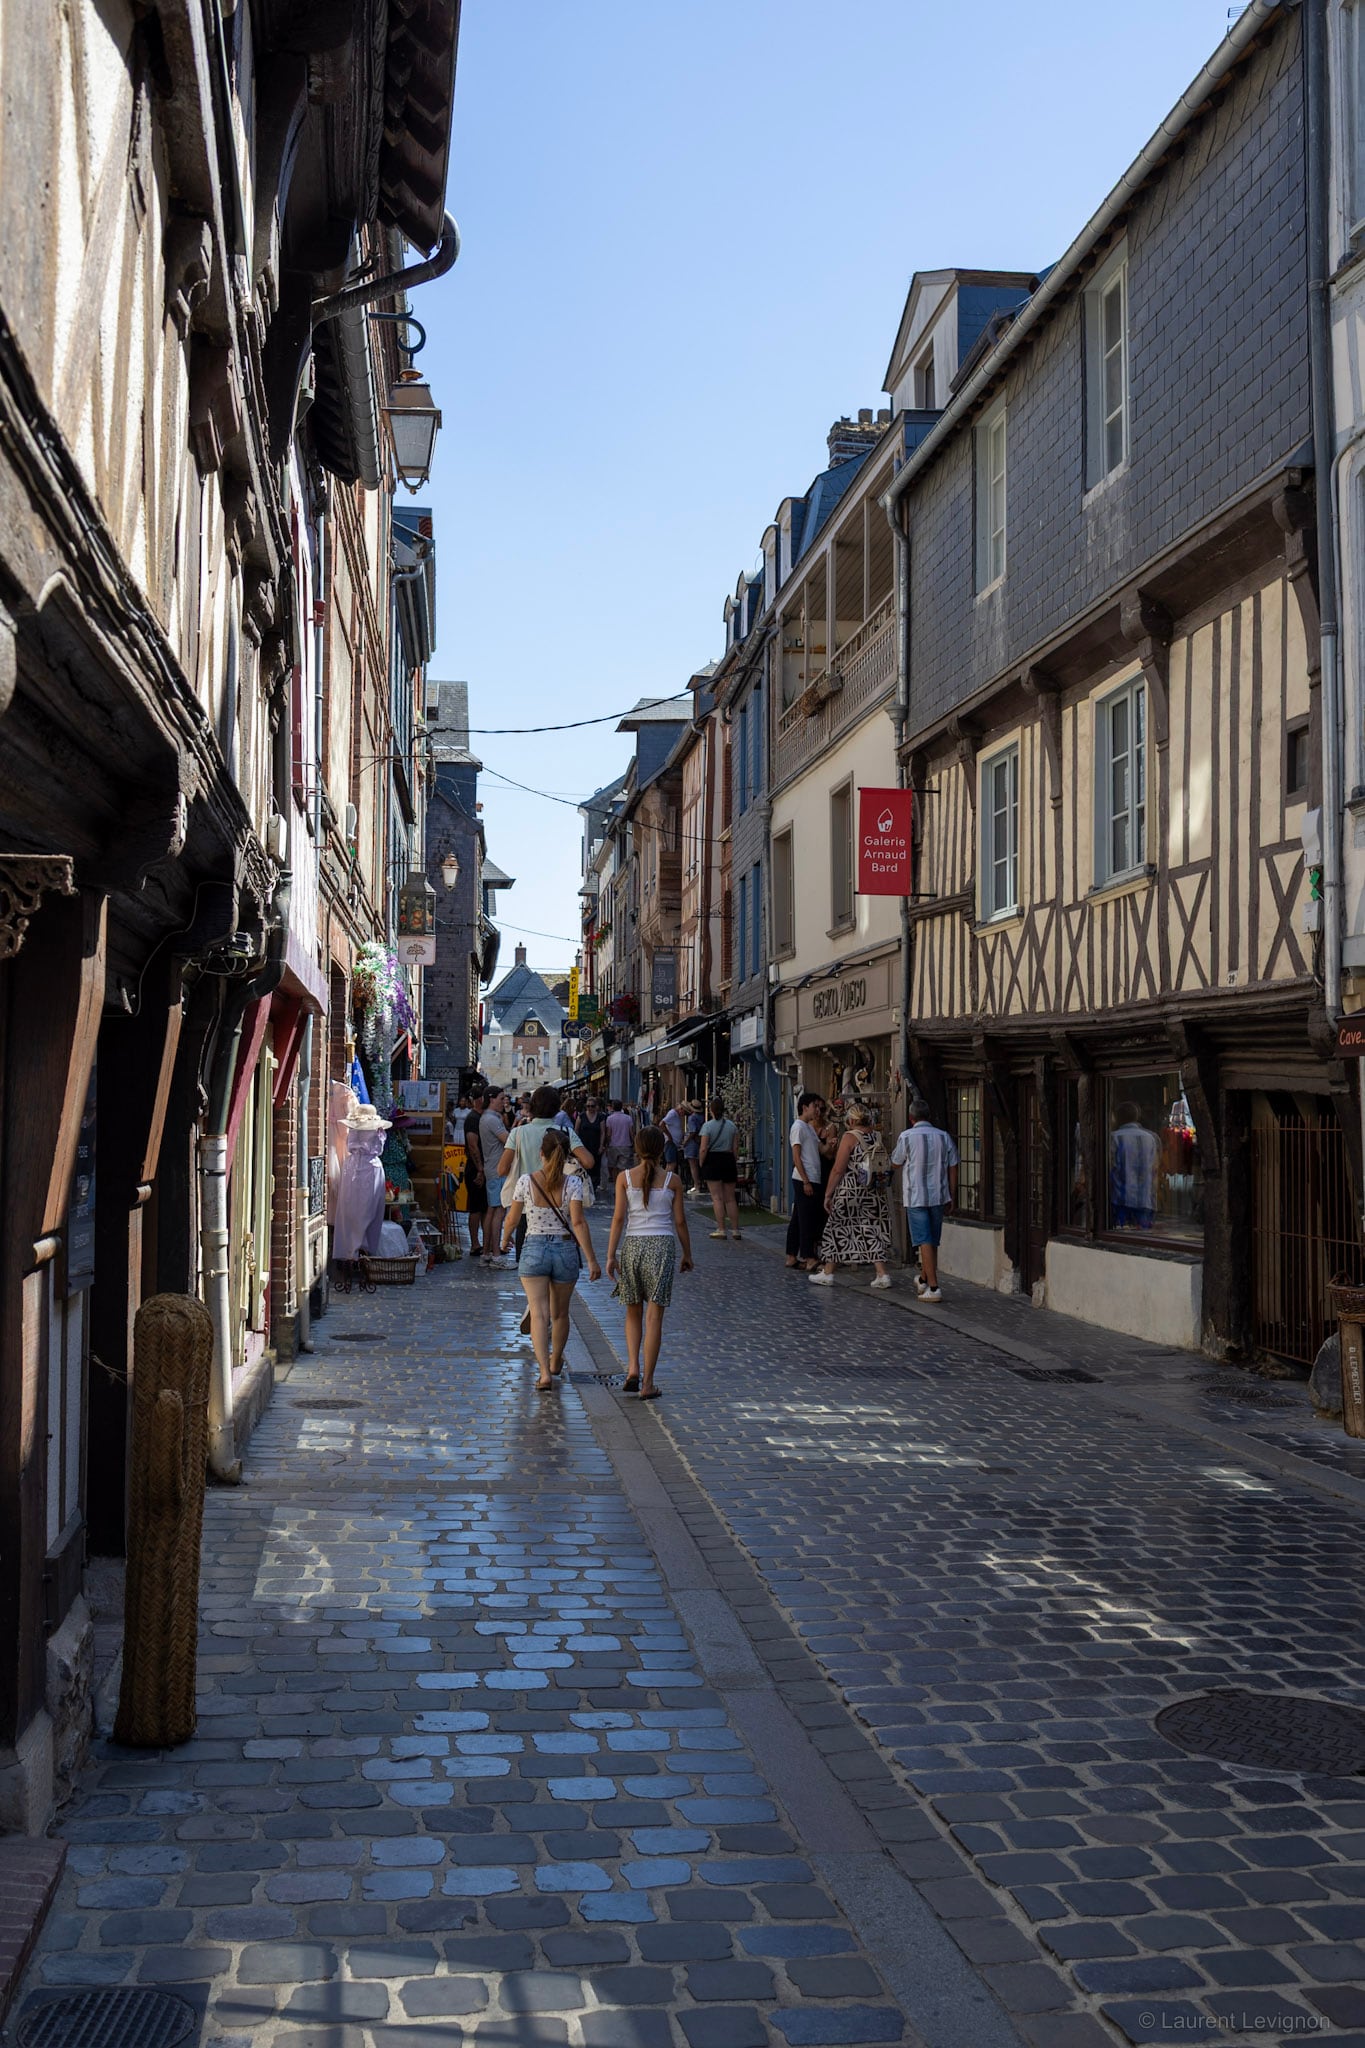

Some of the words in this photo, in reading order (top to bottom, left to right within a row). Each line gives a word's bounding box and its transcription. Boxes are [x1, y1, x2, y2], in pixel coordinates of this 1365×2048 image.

[864, 836, 906, 847] Galerie
[864, 849, 907, 860] Arnaud
[871, 862, 898, 873] Bard
[655, 994, 674, 1005] Sel
